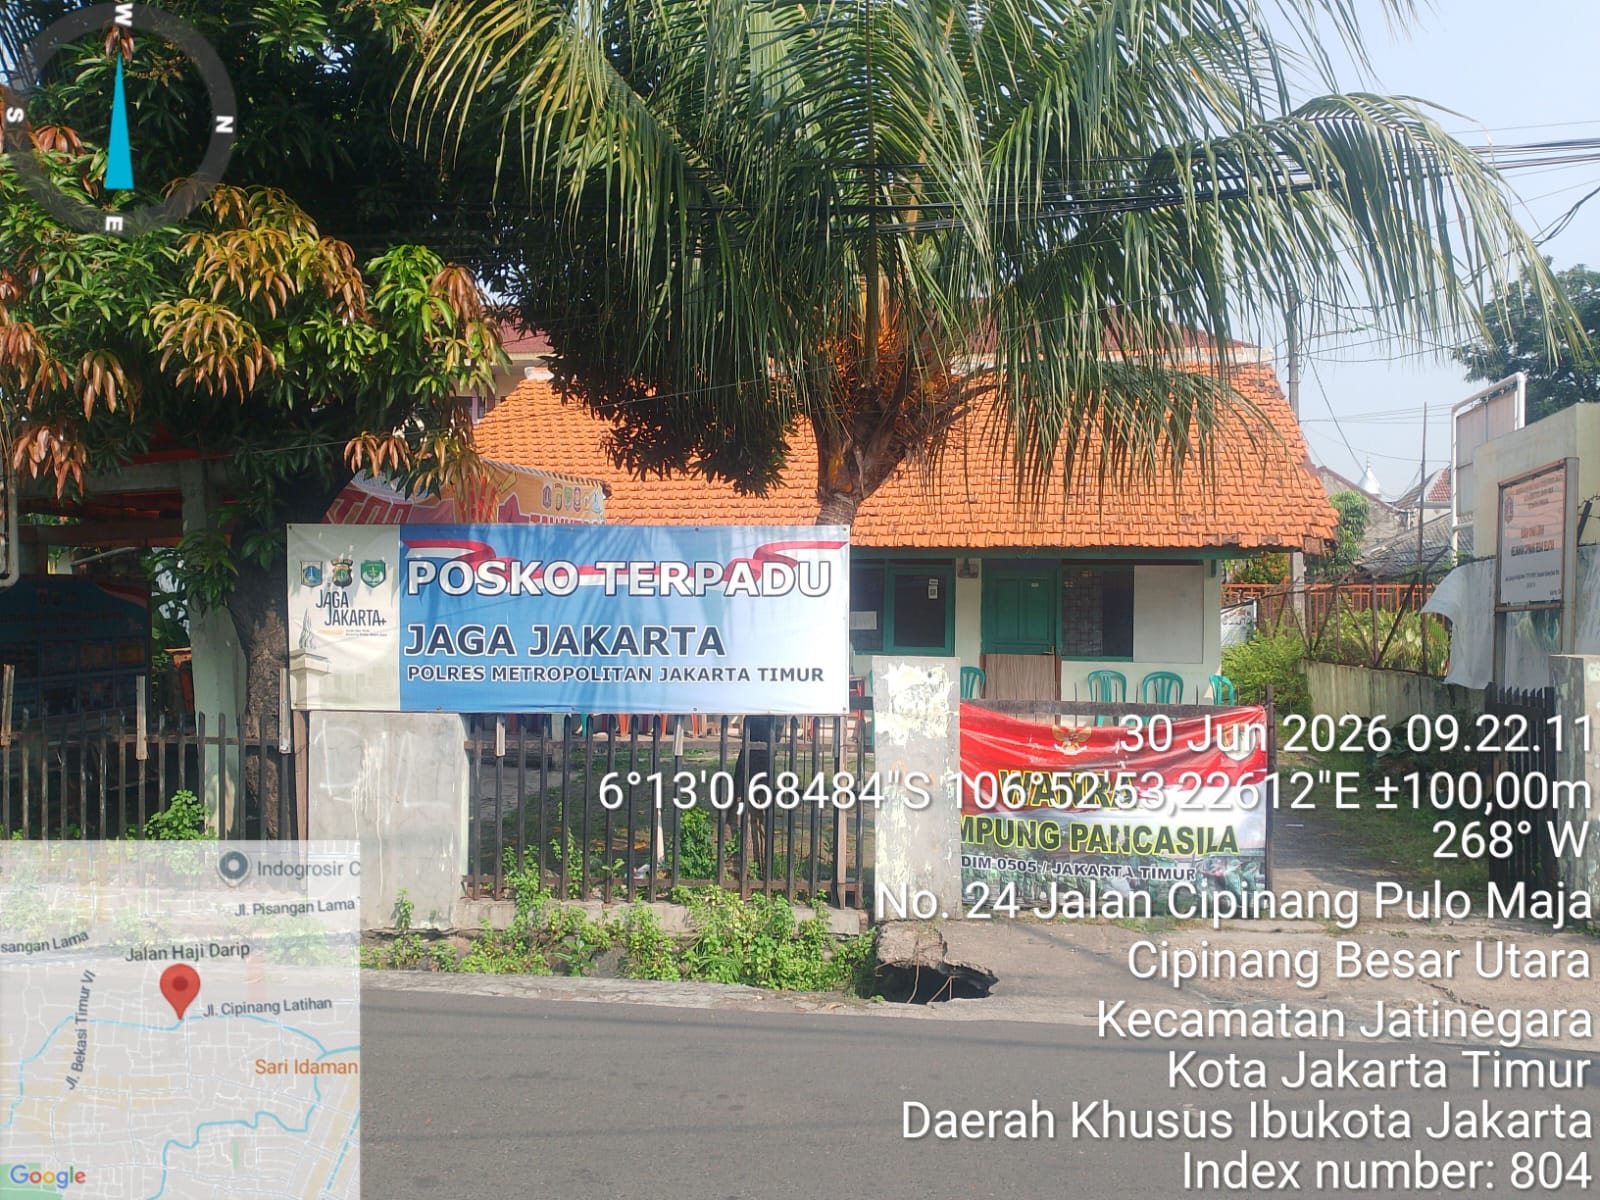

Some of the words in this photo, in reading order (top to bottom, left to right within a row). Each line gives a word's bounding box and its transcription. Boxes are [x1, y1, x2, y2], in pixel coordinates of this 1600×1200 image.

[407, 559, 580, 597] POSKO
[600, 560, 832, 597] TERPADU
[316, 589, 349, 608] JAGA
[405, 624, 517, 658] JAGA
[529, 624, 727, 657] JAKARTA
[407, 665, 484, 682] POLRES
[492, 665, 652, 683] METROPOLITAN
[659, 666, 751, 683] JAKARTA
[760, 667, 824, 683] TIMUR
[1071, 823, 1240, 855] PANCASILA
[997, 858, 1037, 873] 0505
[1053, 863, 1136, 879] JAKARTA
[1140, 866, 1198, 881] TIMUR
